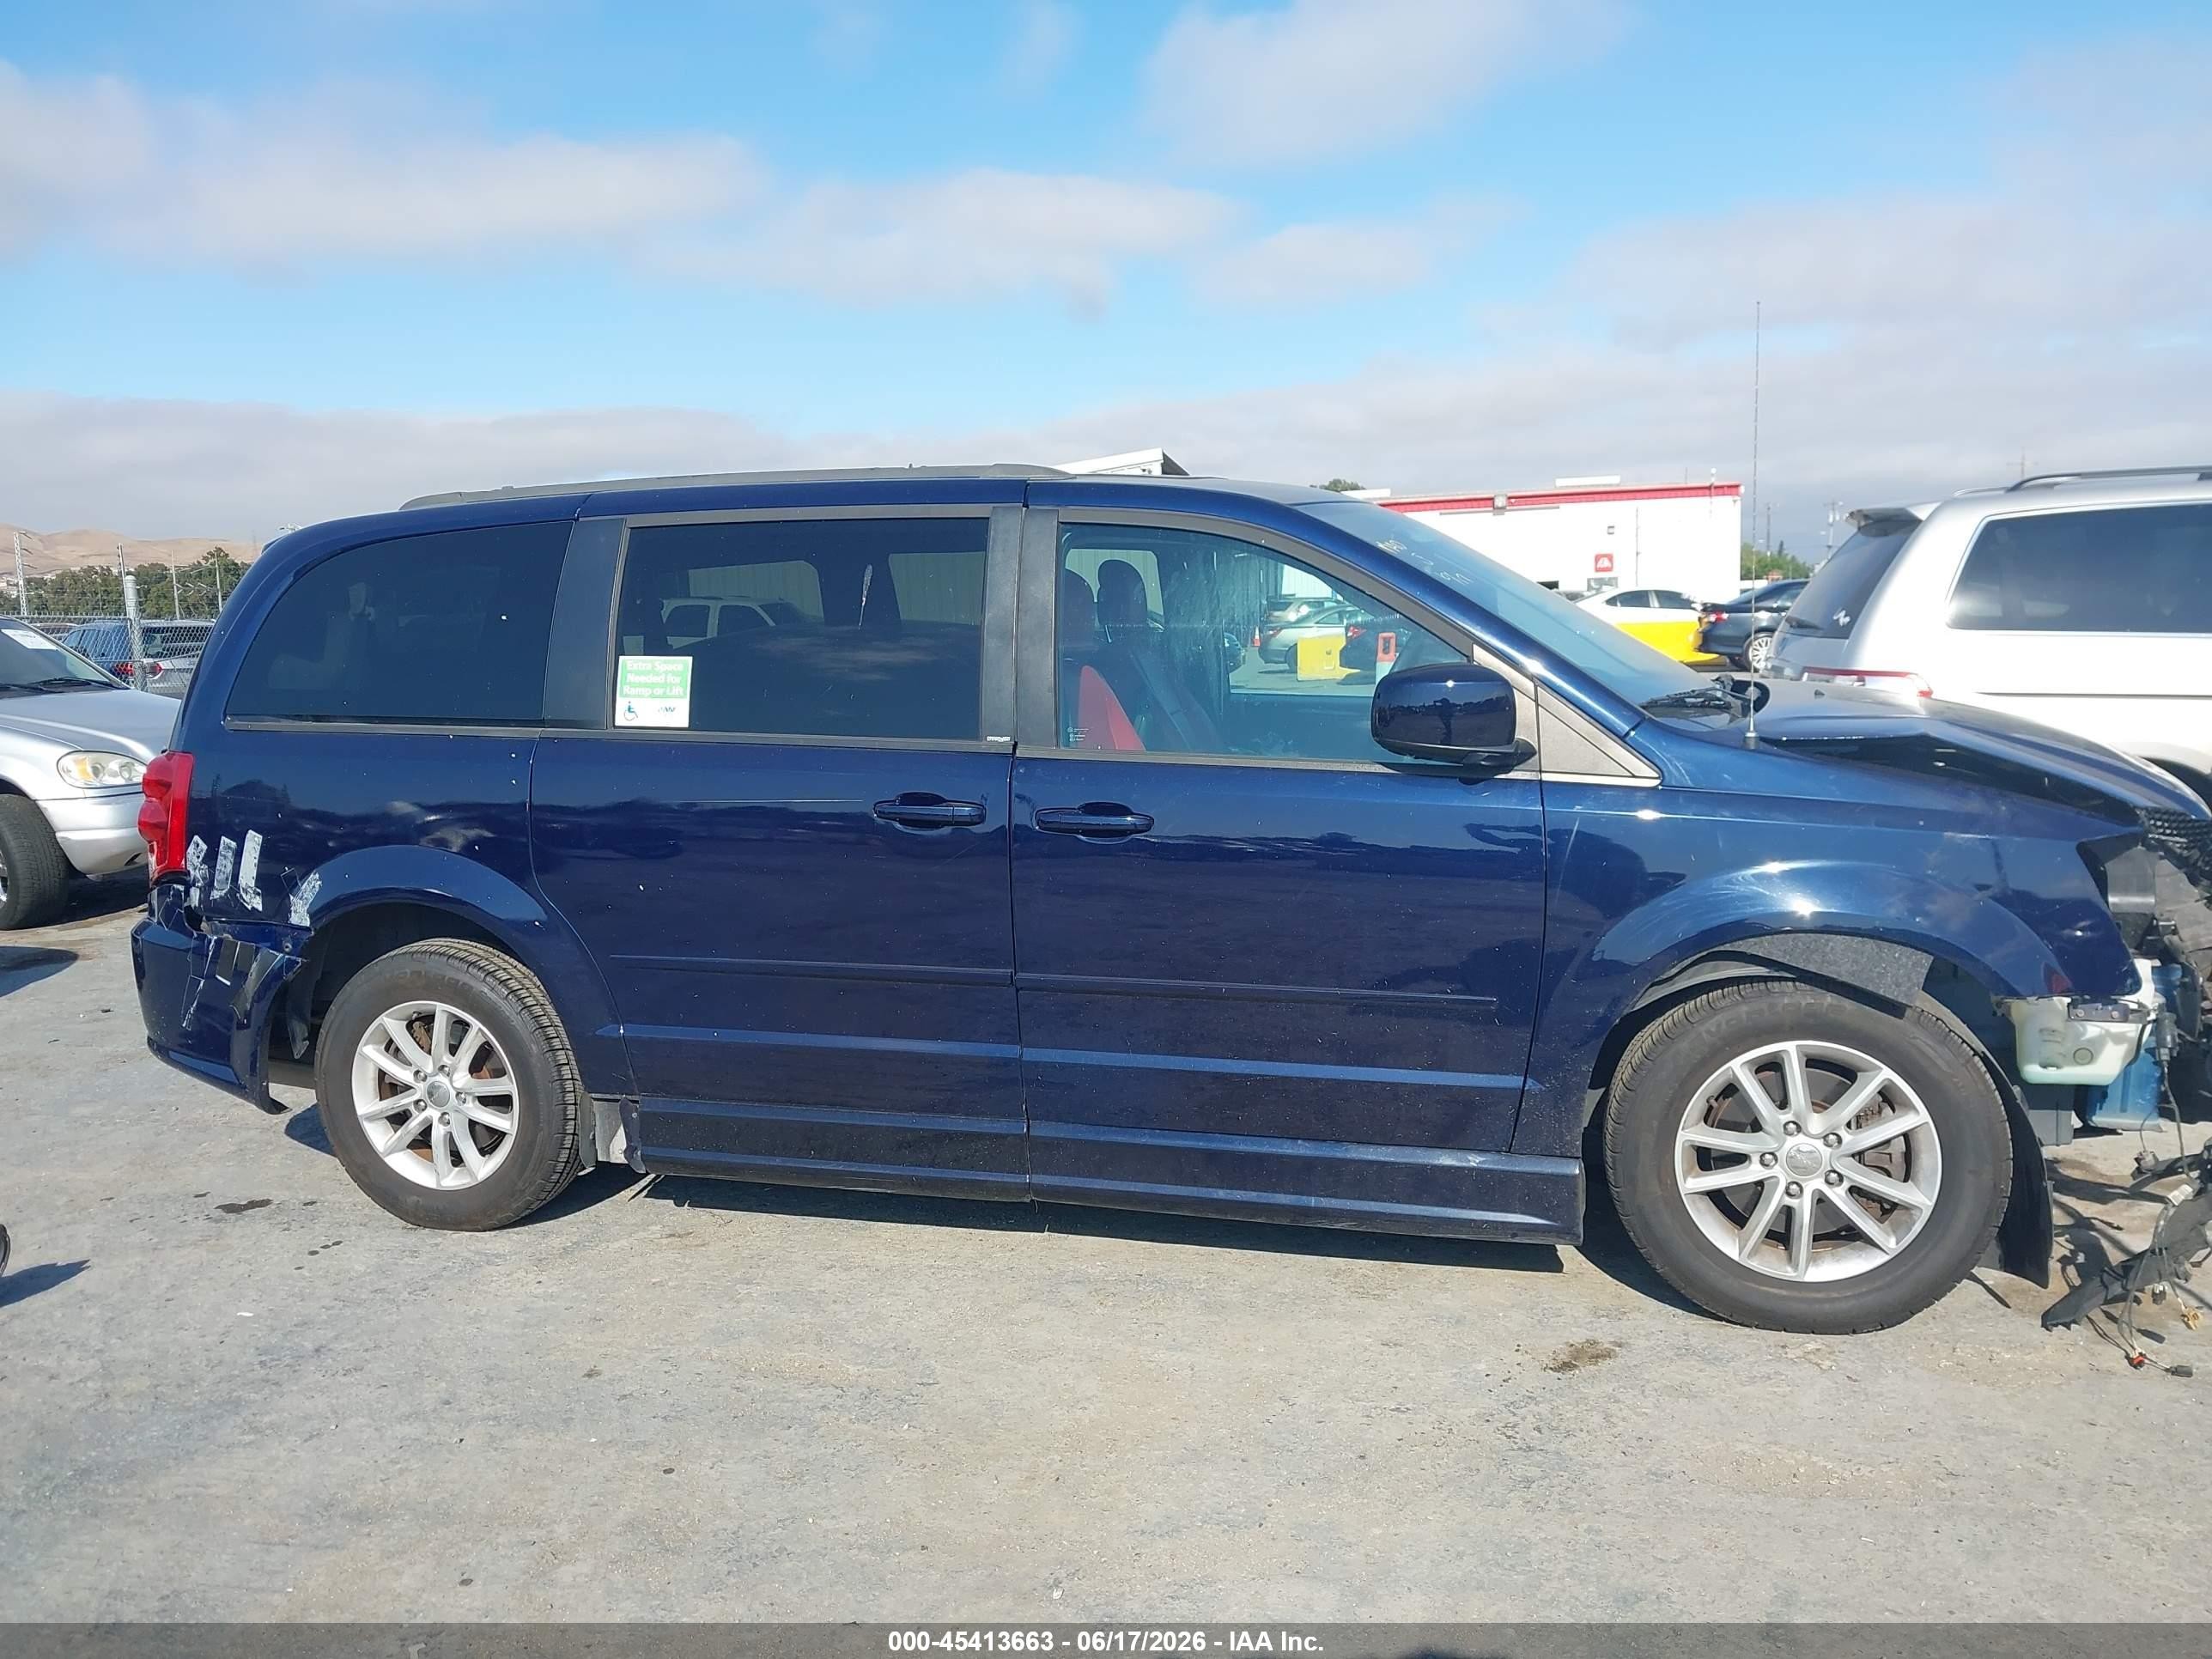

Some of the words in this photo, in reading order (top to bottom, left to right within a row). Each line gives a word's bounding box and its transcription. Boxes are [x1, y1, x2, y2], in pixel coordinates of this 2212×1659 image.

[626, 659, 652, 670] Extra
[653, 660, 684, 672] Space
[626, 672, 665, 684] Needed
[666, 673, 682, 684] for
[623, 685, 652, 697] Ramp
[653, 688, 665, 696] or
[666, 686, 684, 696] Lift
